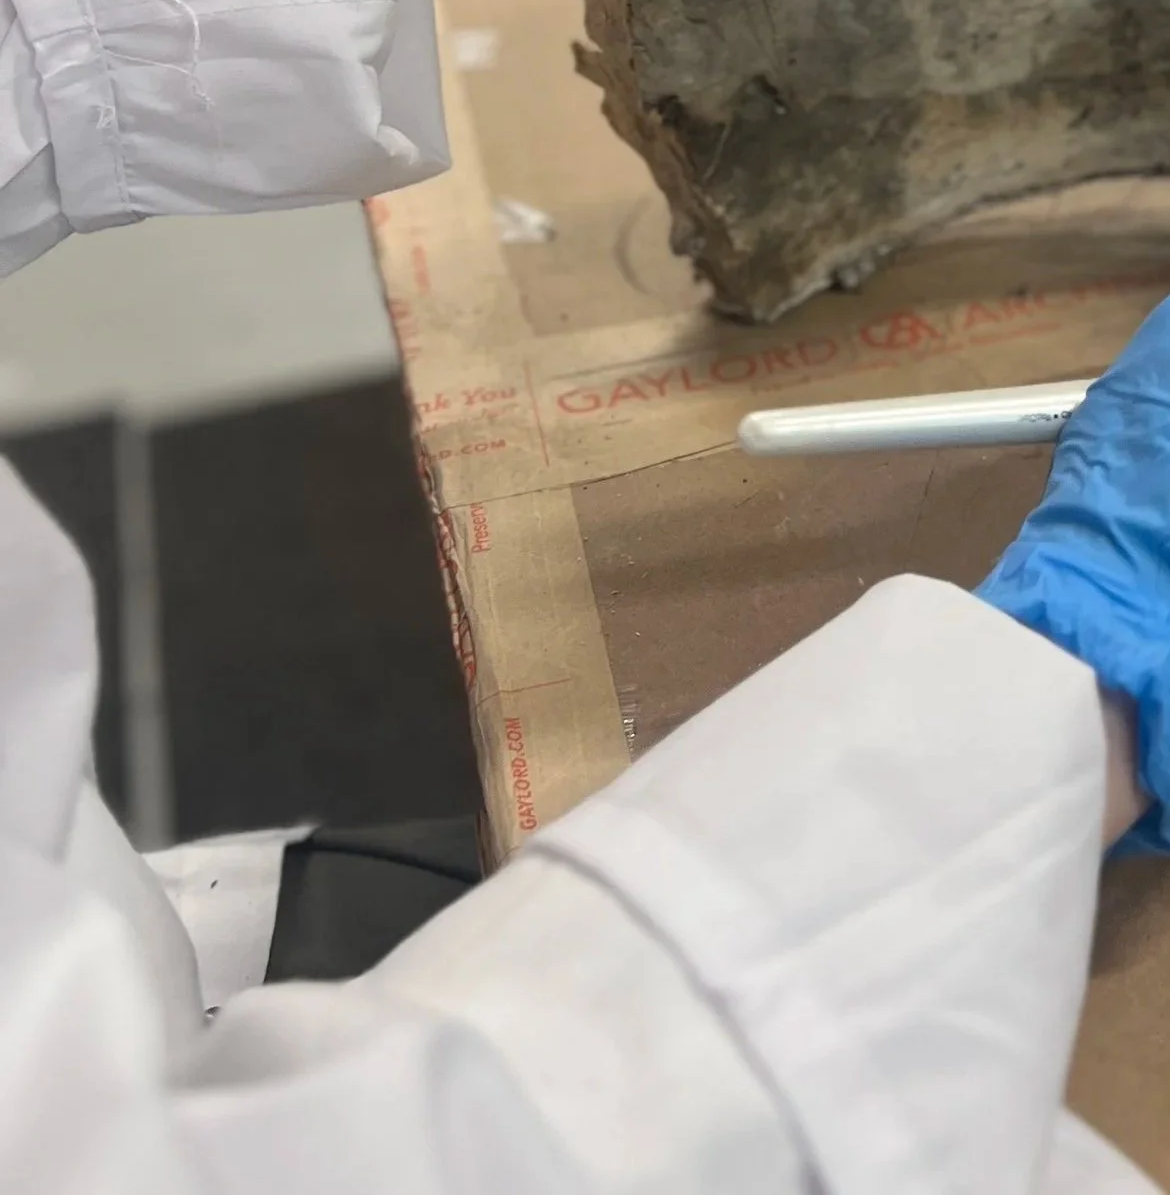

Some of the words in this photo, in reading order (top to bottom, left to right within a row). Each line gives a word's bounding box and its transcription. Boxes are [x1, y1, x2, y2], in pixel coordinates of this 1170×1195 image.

[461, 385, 517, 407] You
[557, 335, 837, 415] GAYLORD
[504, 717, 538, 831] GAYLORD.COM
